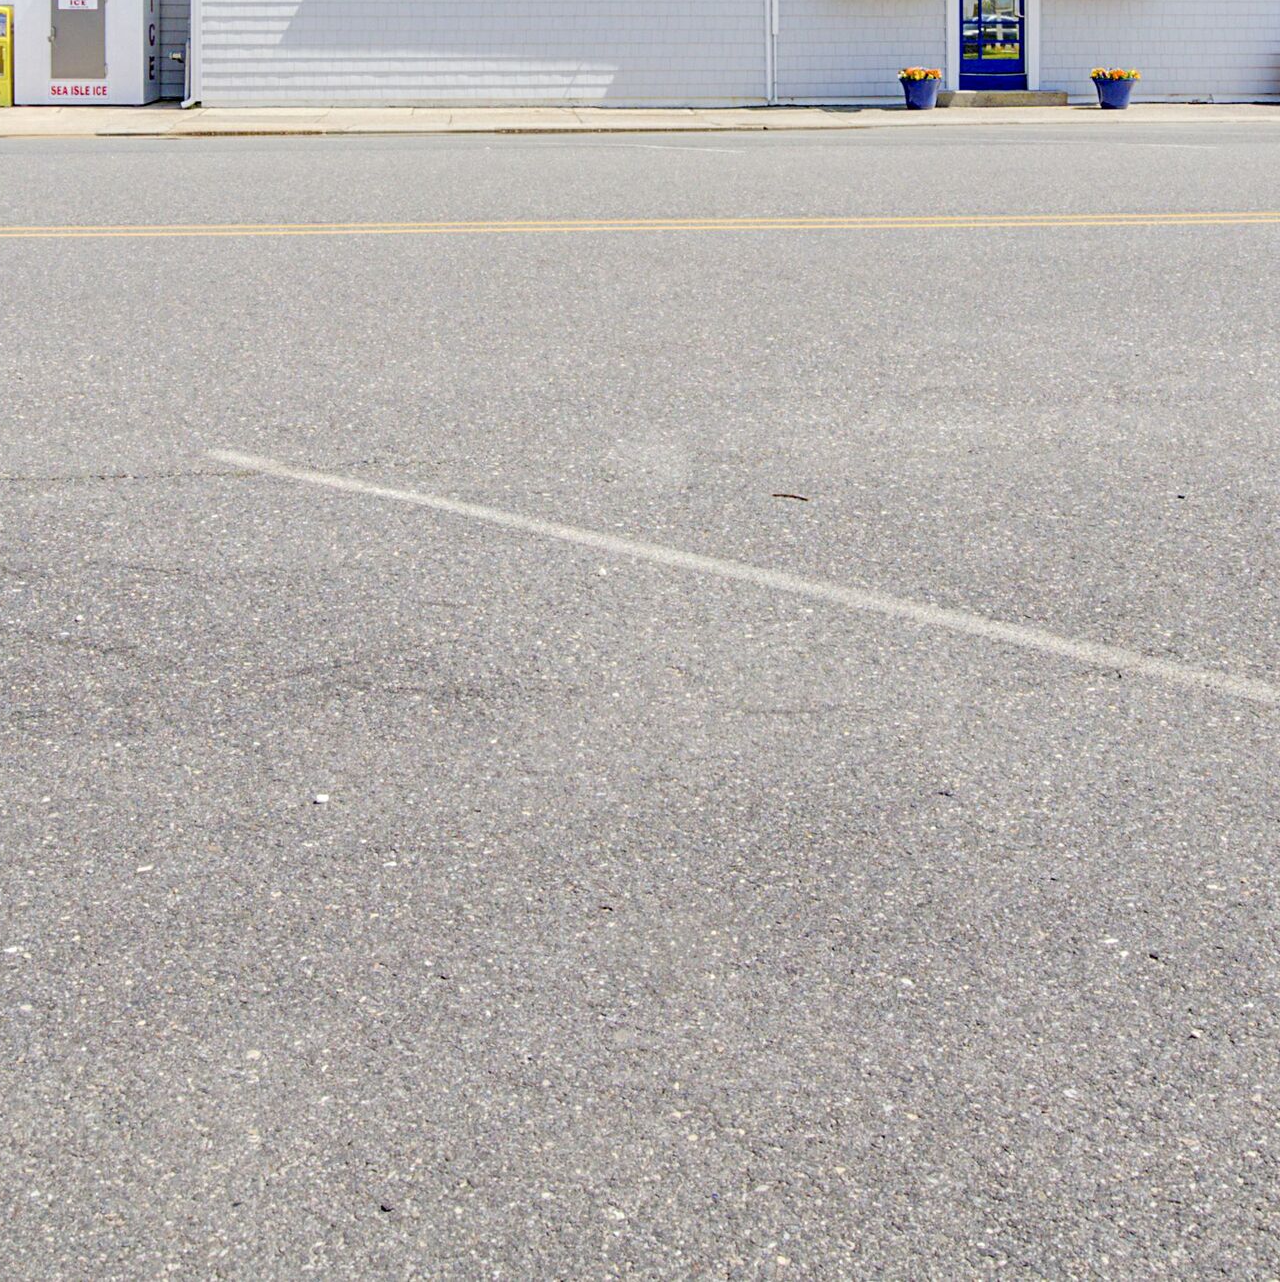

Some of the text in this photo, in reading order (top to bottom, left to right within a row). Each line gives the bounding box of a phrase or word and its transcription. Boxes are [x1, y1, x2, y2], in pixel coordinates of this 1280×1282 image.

[51, 86, 107, 96] SEA ISLE ICE
